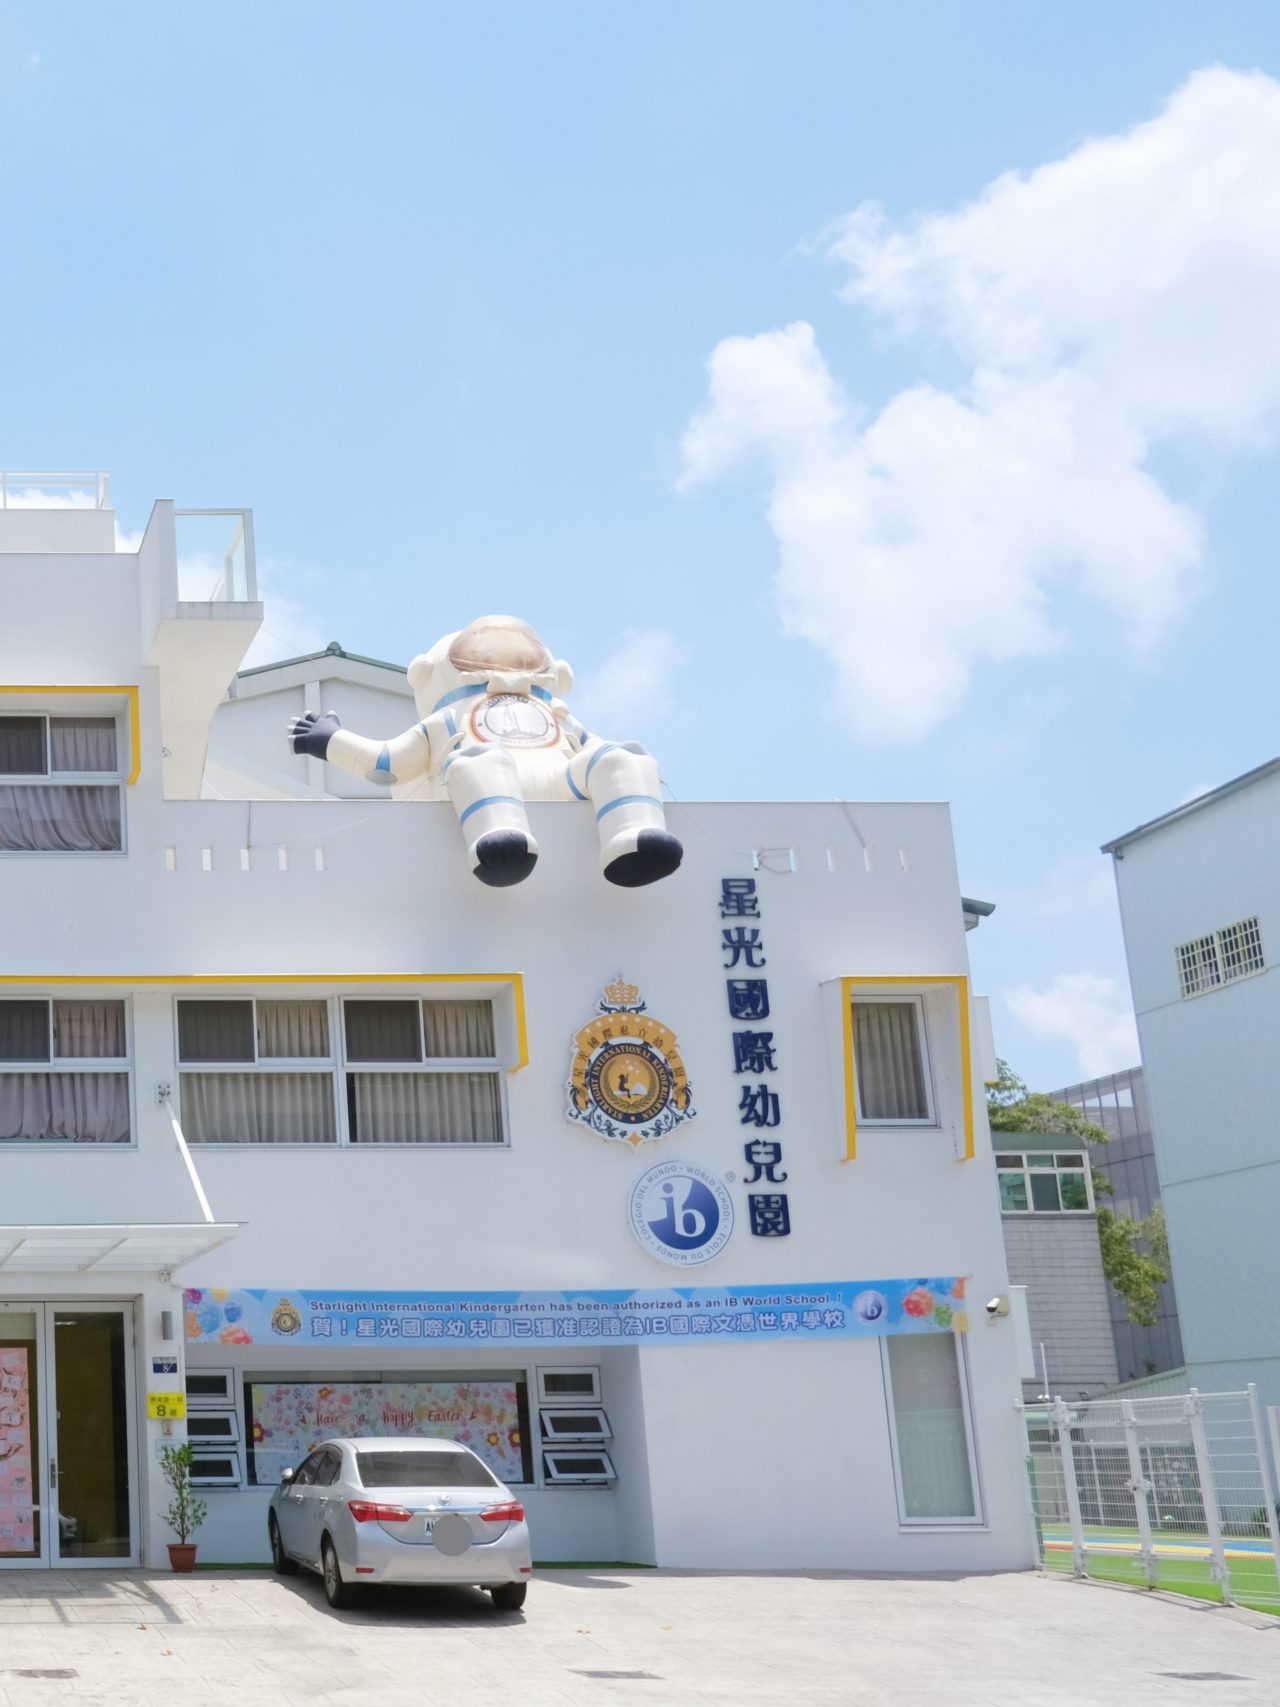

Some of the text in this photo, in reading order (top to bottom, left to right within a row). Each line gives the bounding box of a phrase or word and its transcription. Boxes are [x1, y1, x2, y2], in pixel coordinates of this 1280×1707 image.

[718, 878, 791, 1237] 星光國際幼兒園
[591, 1045, 669, 1120] STARLIGHT INTERNATIONAL KINDERGARTEN
[634, 1165, 678, 1241] COLEGIO DEL MUNDO
[686, 1166, 731, 1222] WORLD SCHOOL
[656, 1244, 688, 1262] MONDE
[691, 1251, 704, 1261] DU
[310, 1301, 368, 1313] Starlight
[371, 1301, 455, 1313] International
[460, 1301, 545, 1313] Kindergarten
[549, 1301, 573, 1312] has
[576, 1301, 610, 1312] been
[613, 1299, 682, 1310] authorized
[686, 1299, 702, 1309] as
[705, 1299, 721, 1308] an
[725, 1297, 738, 1307] IB
[741, 1295, 781, 1307] World
[785, 1293, 829, 1305] School
[428, 1409, 461, 1422] Easter
